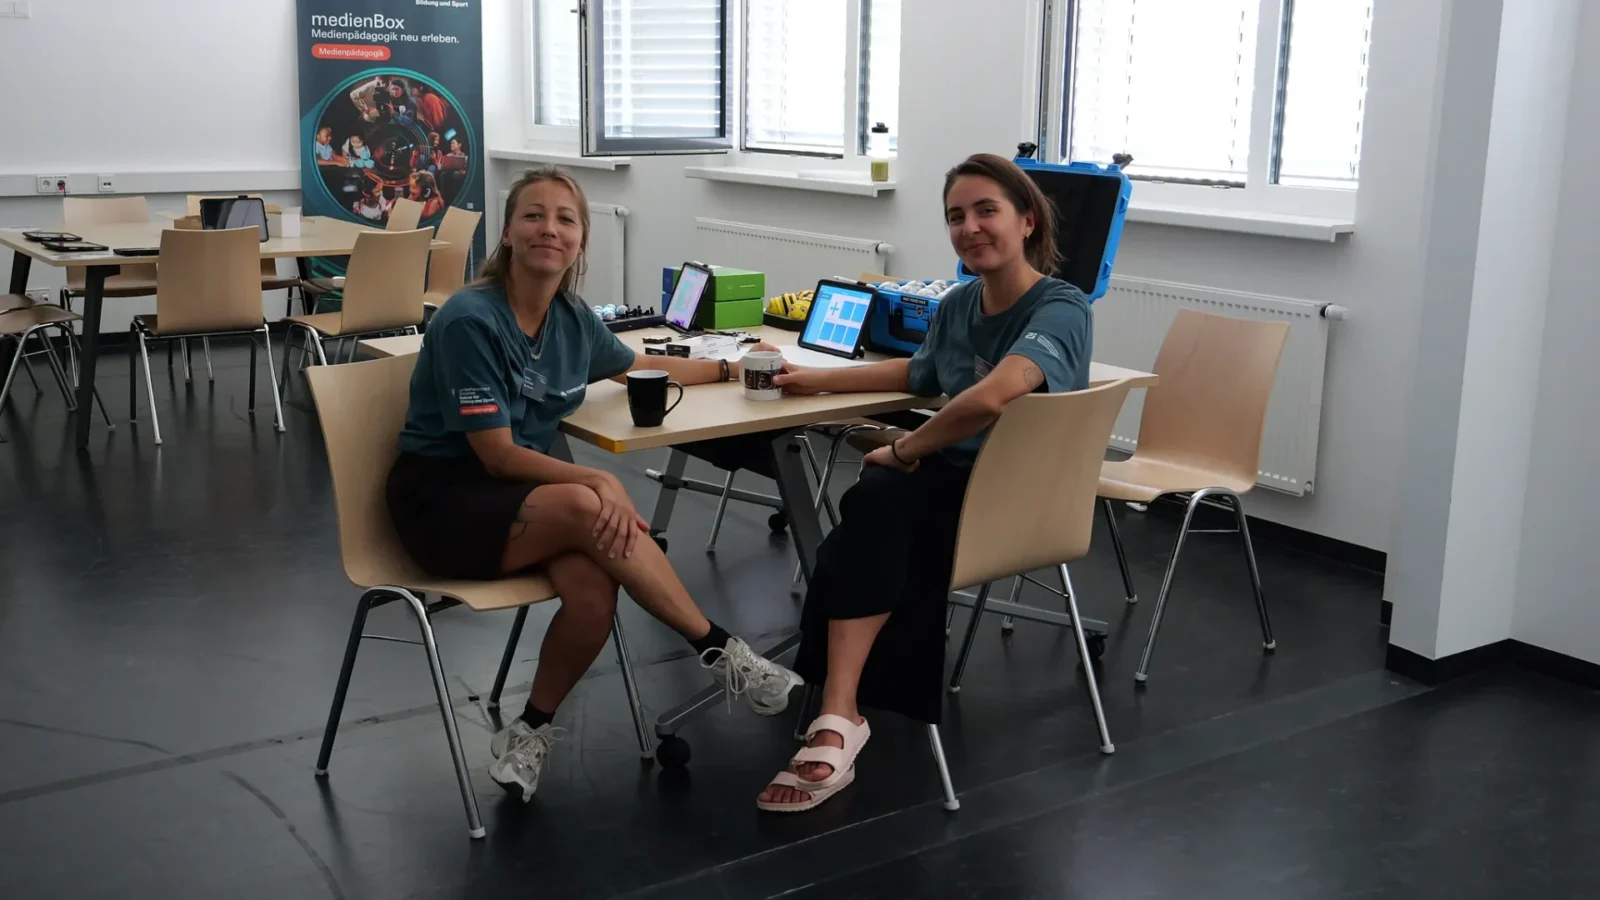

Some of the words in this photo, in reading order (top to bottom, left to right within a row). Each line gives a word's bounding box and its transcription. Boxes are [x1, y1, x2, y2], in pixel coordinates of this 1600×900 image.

[451, 0, 469, 8] Sport
[311, 13, 405, 30] medienBox
[311, 29, 398, 43] Medienpädagogik
[400, 34, 419, 42] neu
[421, 34, 460, 44] erleben.
[318, 47, 385, 58] Medienpädagogik
